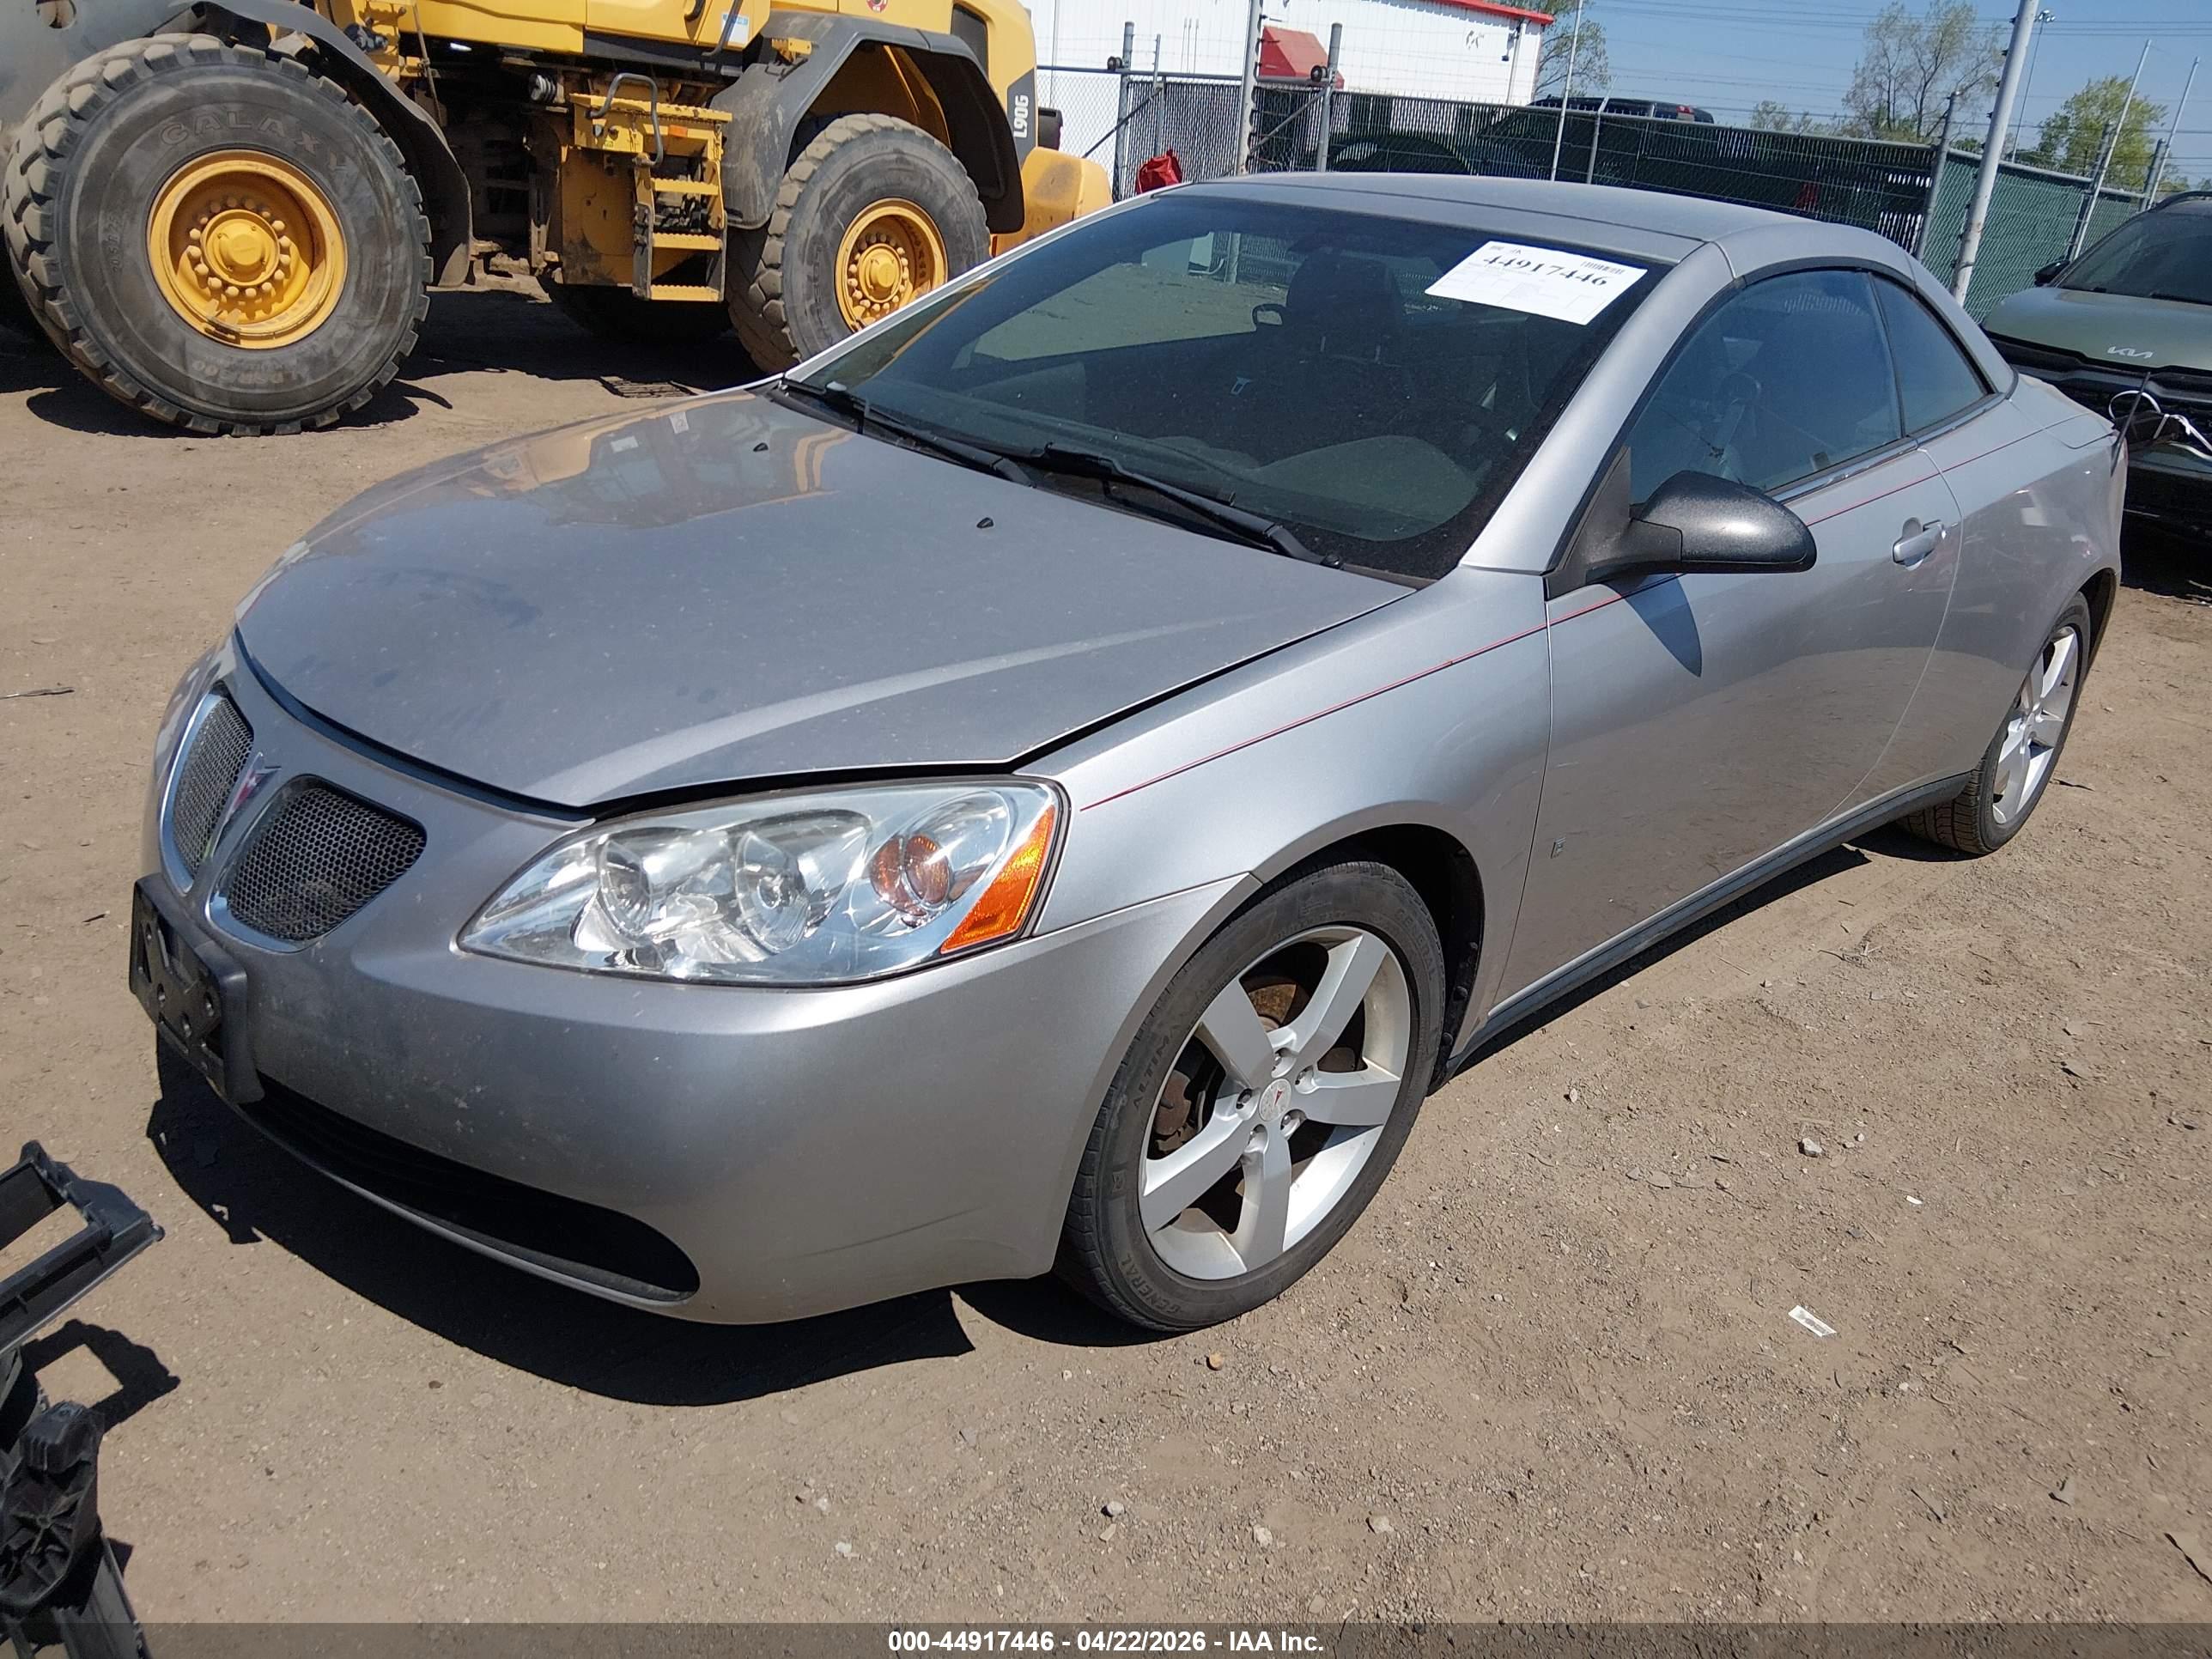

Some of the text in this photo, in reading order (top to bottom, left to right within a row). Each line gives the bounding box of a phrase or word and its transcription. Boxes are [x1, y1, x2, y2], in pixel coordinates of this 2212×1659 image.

[160, 110, 354, 173] GALAXY
[1013, 94, 1029, 137] L90G
[1483, 255, 1607, 286] 44917446
[1118, 1252, 1182, 1314] GENERAL
